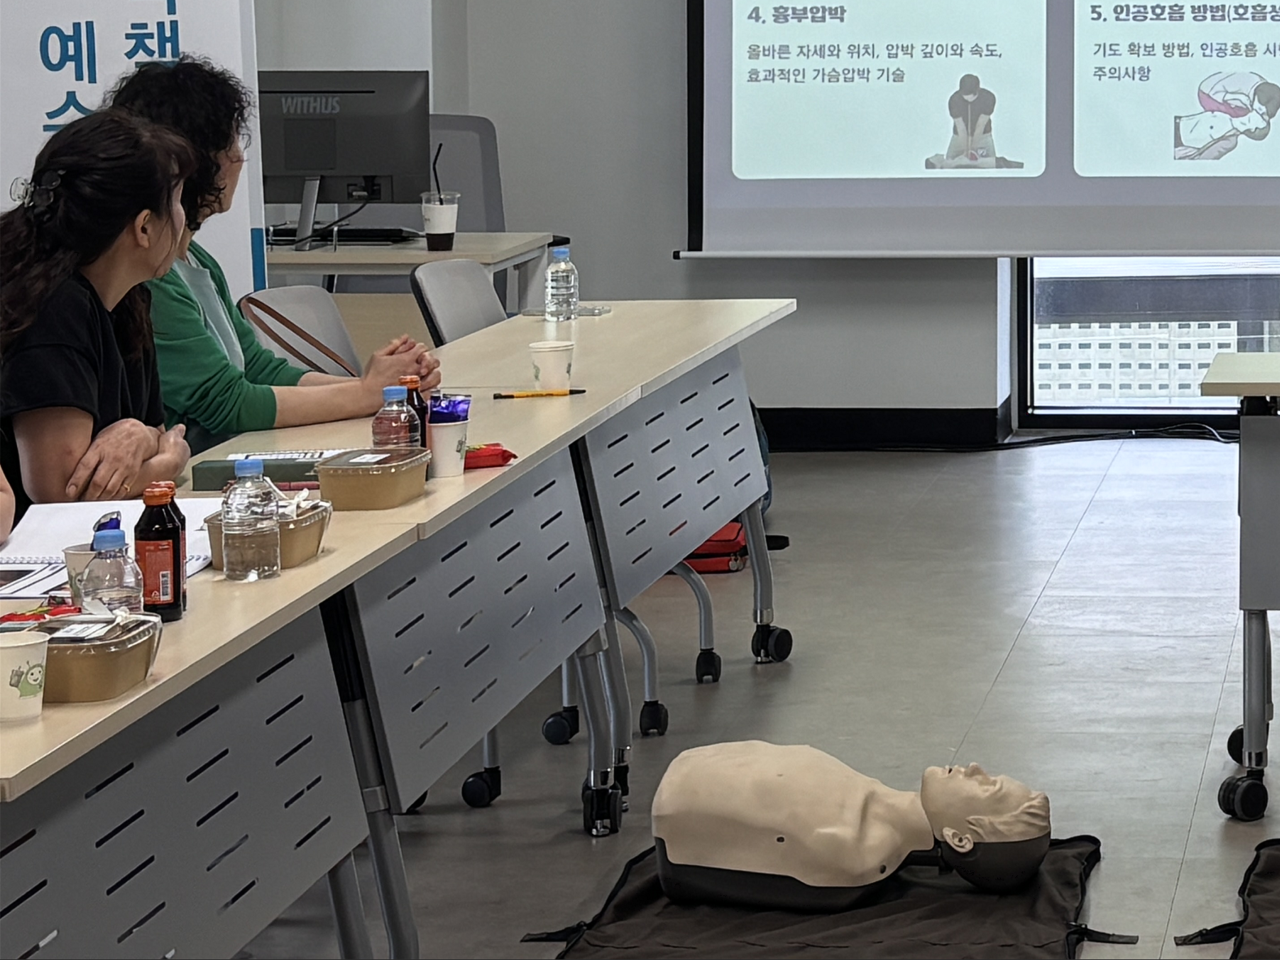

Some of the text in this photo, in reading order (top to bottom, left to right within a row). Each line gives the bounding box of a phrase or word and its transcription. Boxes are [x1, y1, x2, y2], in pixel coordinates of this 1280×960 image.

[747, 5, 846, 24] 4. 흉부압박
[1090, 5, 1107, 22] 5.
[1113, 4, 1185, 22] 인공호흡
[747, 43, 1002, 59] 올바른 자세와 위치, 압박 깊이와 속도,
[1092, 43, 1122, 57] 기도
[1127, 42, 1156, 57] 확보
[1162, 42, 1195, 58] 방법,
[1200, 42, 1258, 58] 인공호흡
[747, 68, 905, 83] 효과적인 가슴압박 기술
[1093, 66, 1151, 81] 주의사항
[281, 96, 341, 114] WITHUS
